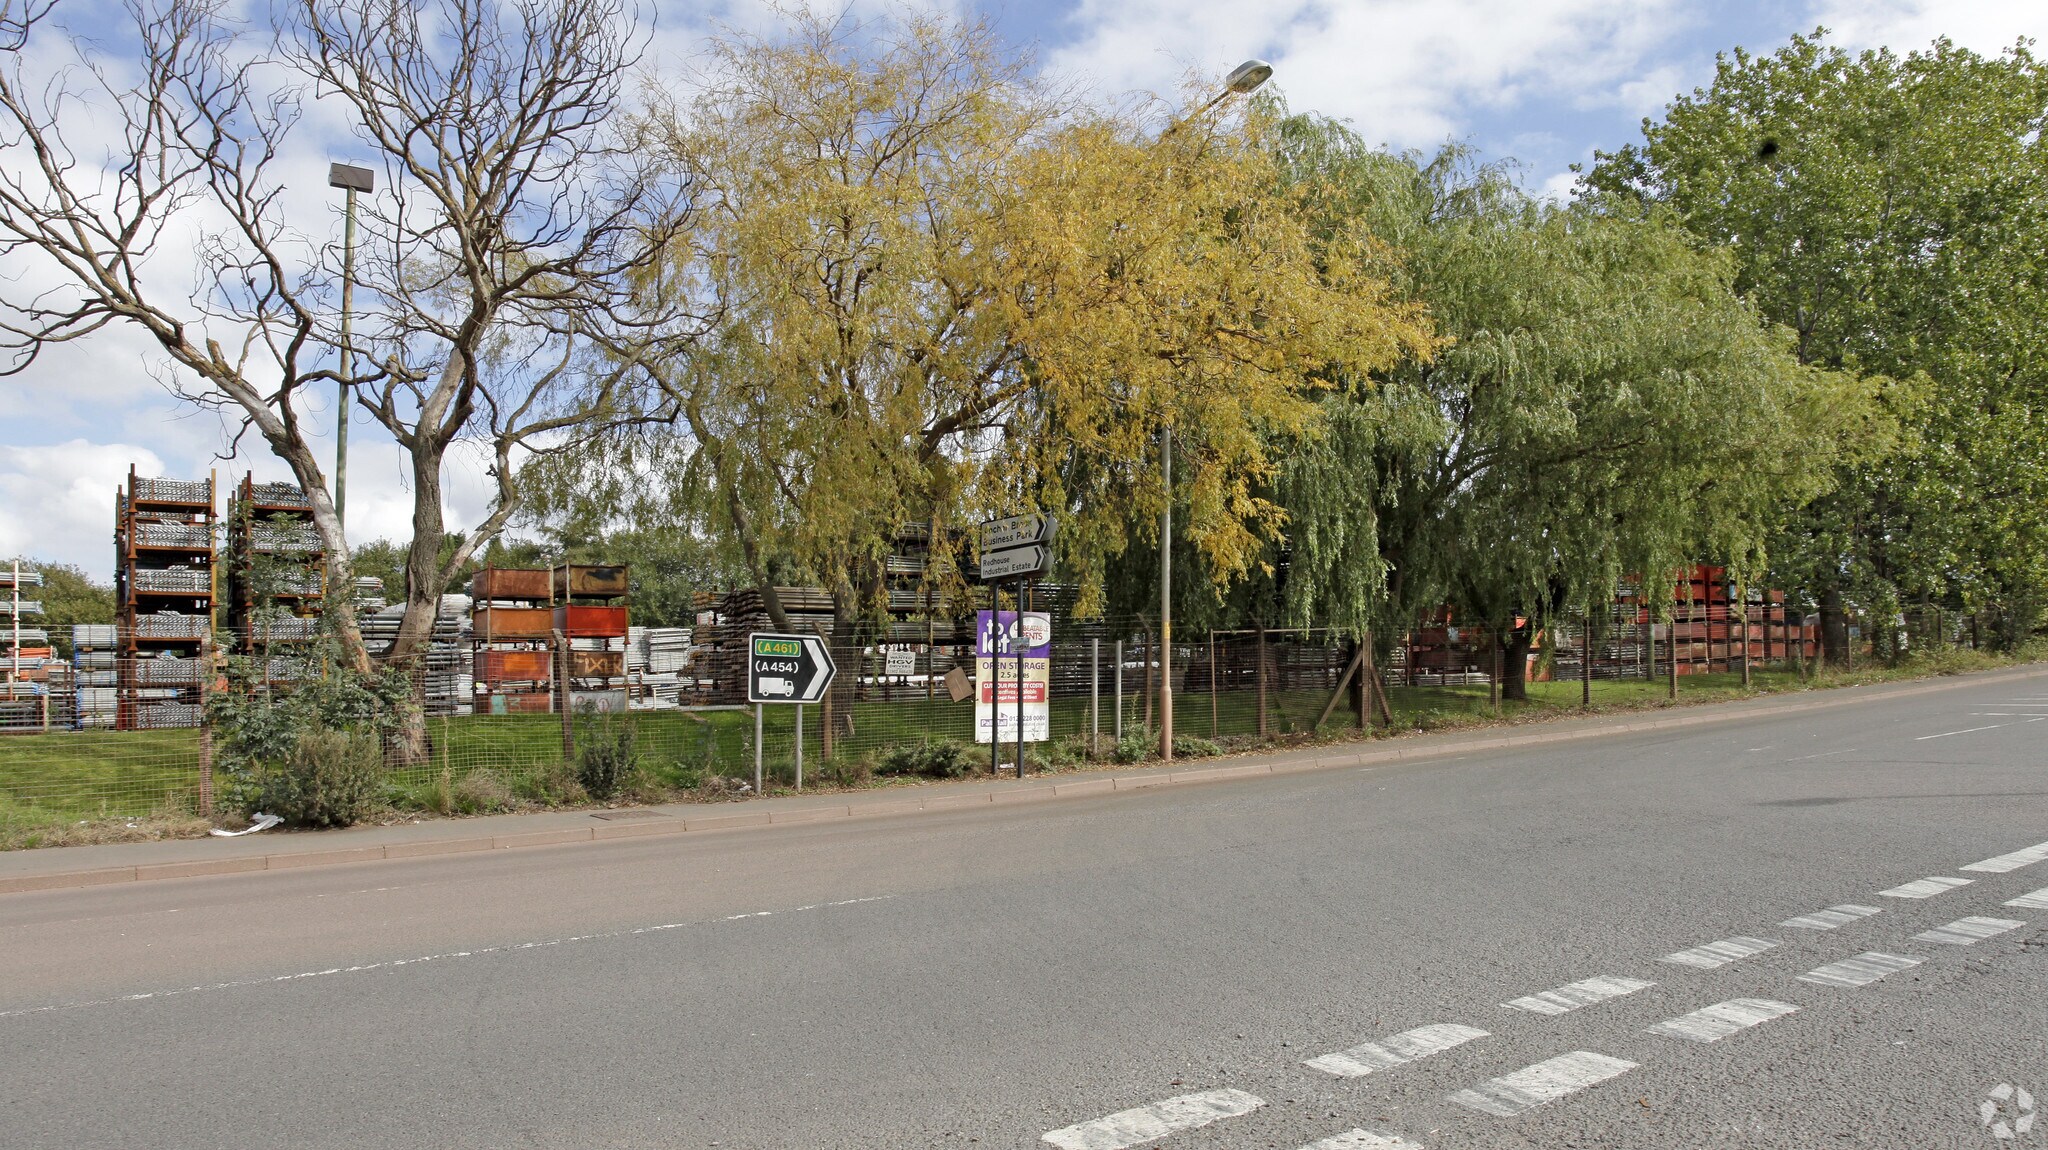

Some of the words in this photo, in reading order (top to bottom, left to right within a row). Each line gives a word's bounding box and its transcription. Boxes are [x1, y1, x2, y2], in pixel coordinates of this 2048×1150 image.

[983, 535, 1013, 546] Business
[1016, 530, 1032, 540] Park
[982, 557, 1010, 567] Redhouse
[982, 566, 1010, 576] Industrial
[1012, 562, 1031, 572] Estate
[986, 619, 1004, 636] to
[982, 632, 1010, 653] let
[982, 662, 1006, 670] OPN
